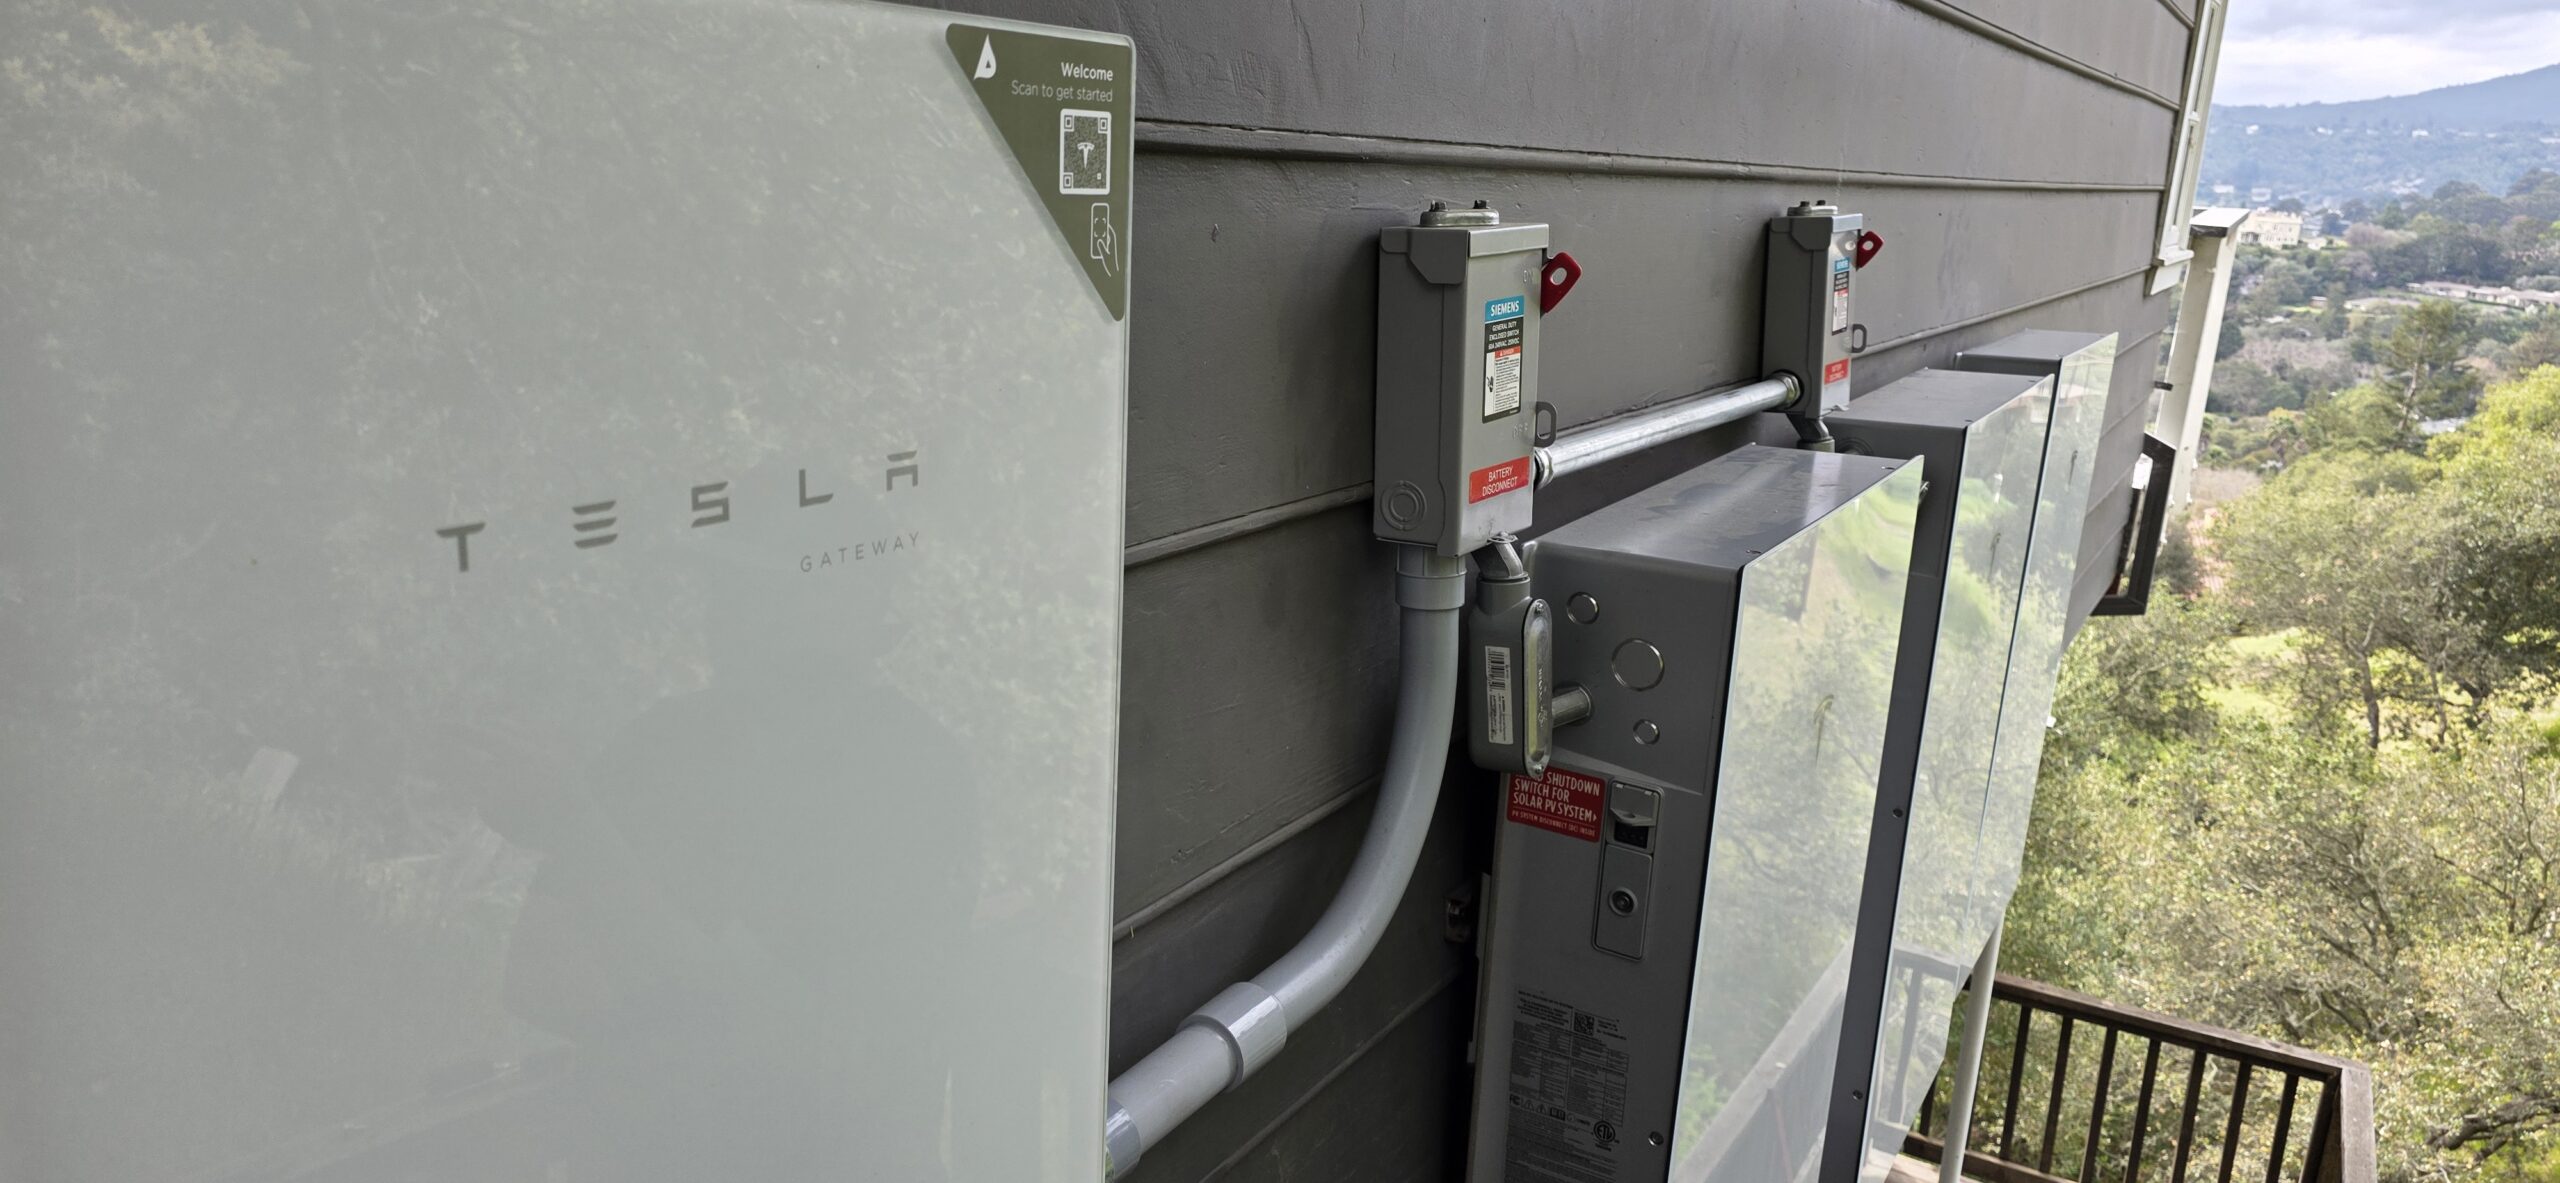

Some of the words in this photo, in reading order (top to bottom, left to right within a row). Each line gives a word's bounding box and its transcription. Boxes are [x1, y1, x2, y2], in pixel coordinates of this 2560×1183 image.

[1060, 61, 1114, 82] Welcome
[1011, 79, 1039, 97] Scan
[1041, 82, 1054, 99] to
[1056, 85, 1074, 102] get
[1076, 86, 1113, 103] started
[1490, 300, 1520, 317] SIEMENS
[1488, 465, 1514, 483] BATTERY
[1482, 476, 1518, 497] DISCONNECT
[435, 450, 919, 573] TESLA
[800, 531, 920, 573] GATEWAY
[1514, 778, 1549, 798] SWITCH
[1552, 786, 1570, 803] FOR
[1546, 771, 1600, 797] SHUTDOWN
[1513, 791, 1542, 811] SOLAR
[1544, 799, 1557, 813] PV
[1557, 802, 1593, 823] SYSTEM
[1520, 811, 1538, 823] SYSTEM
